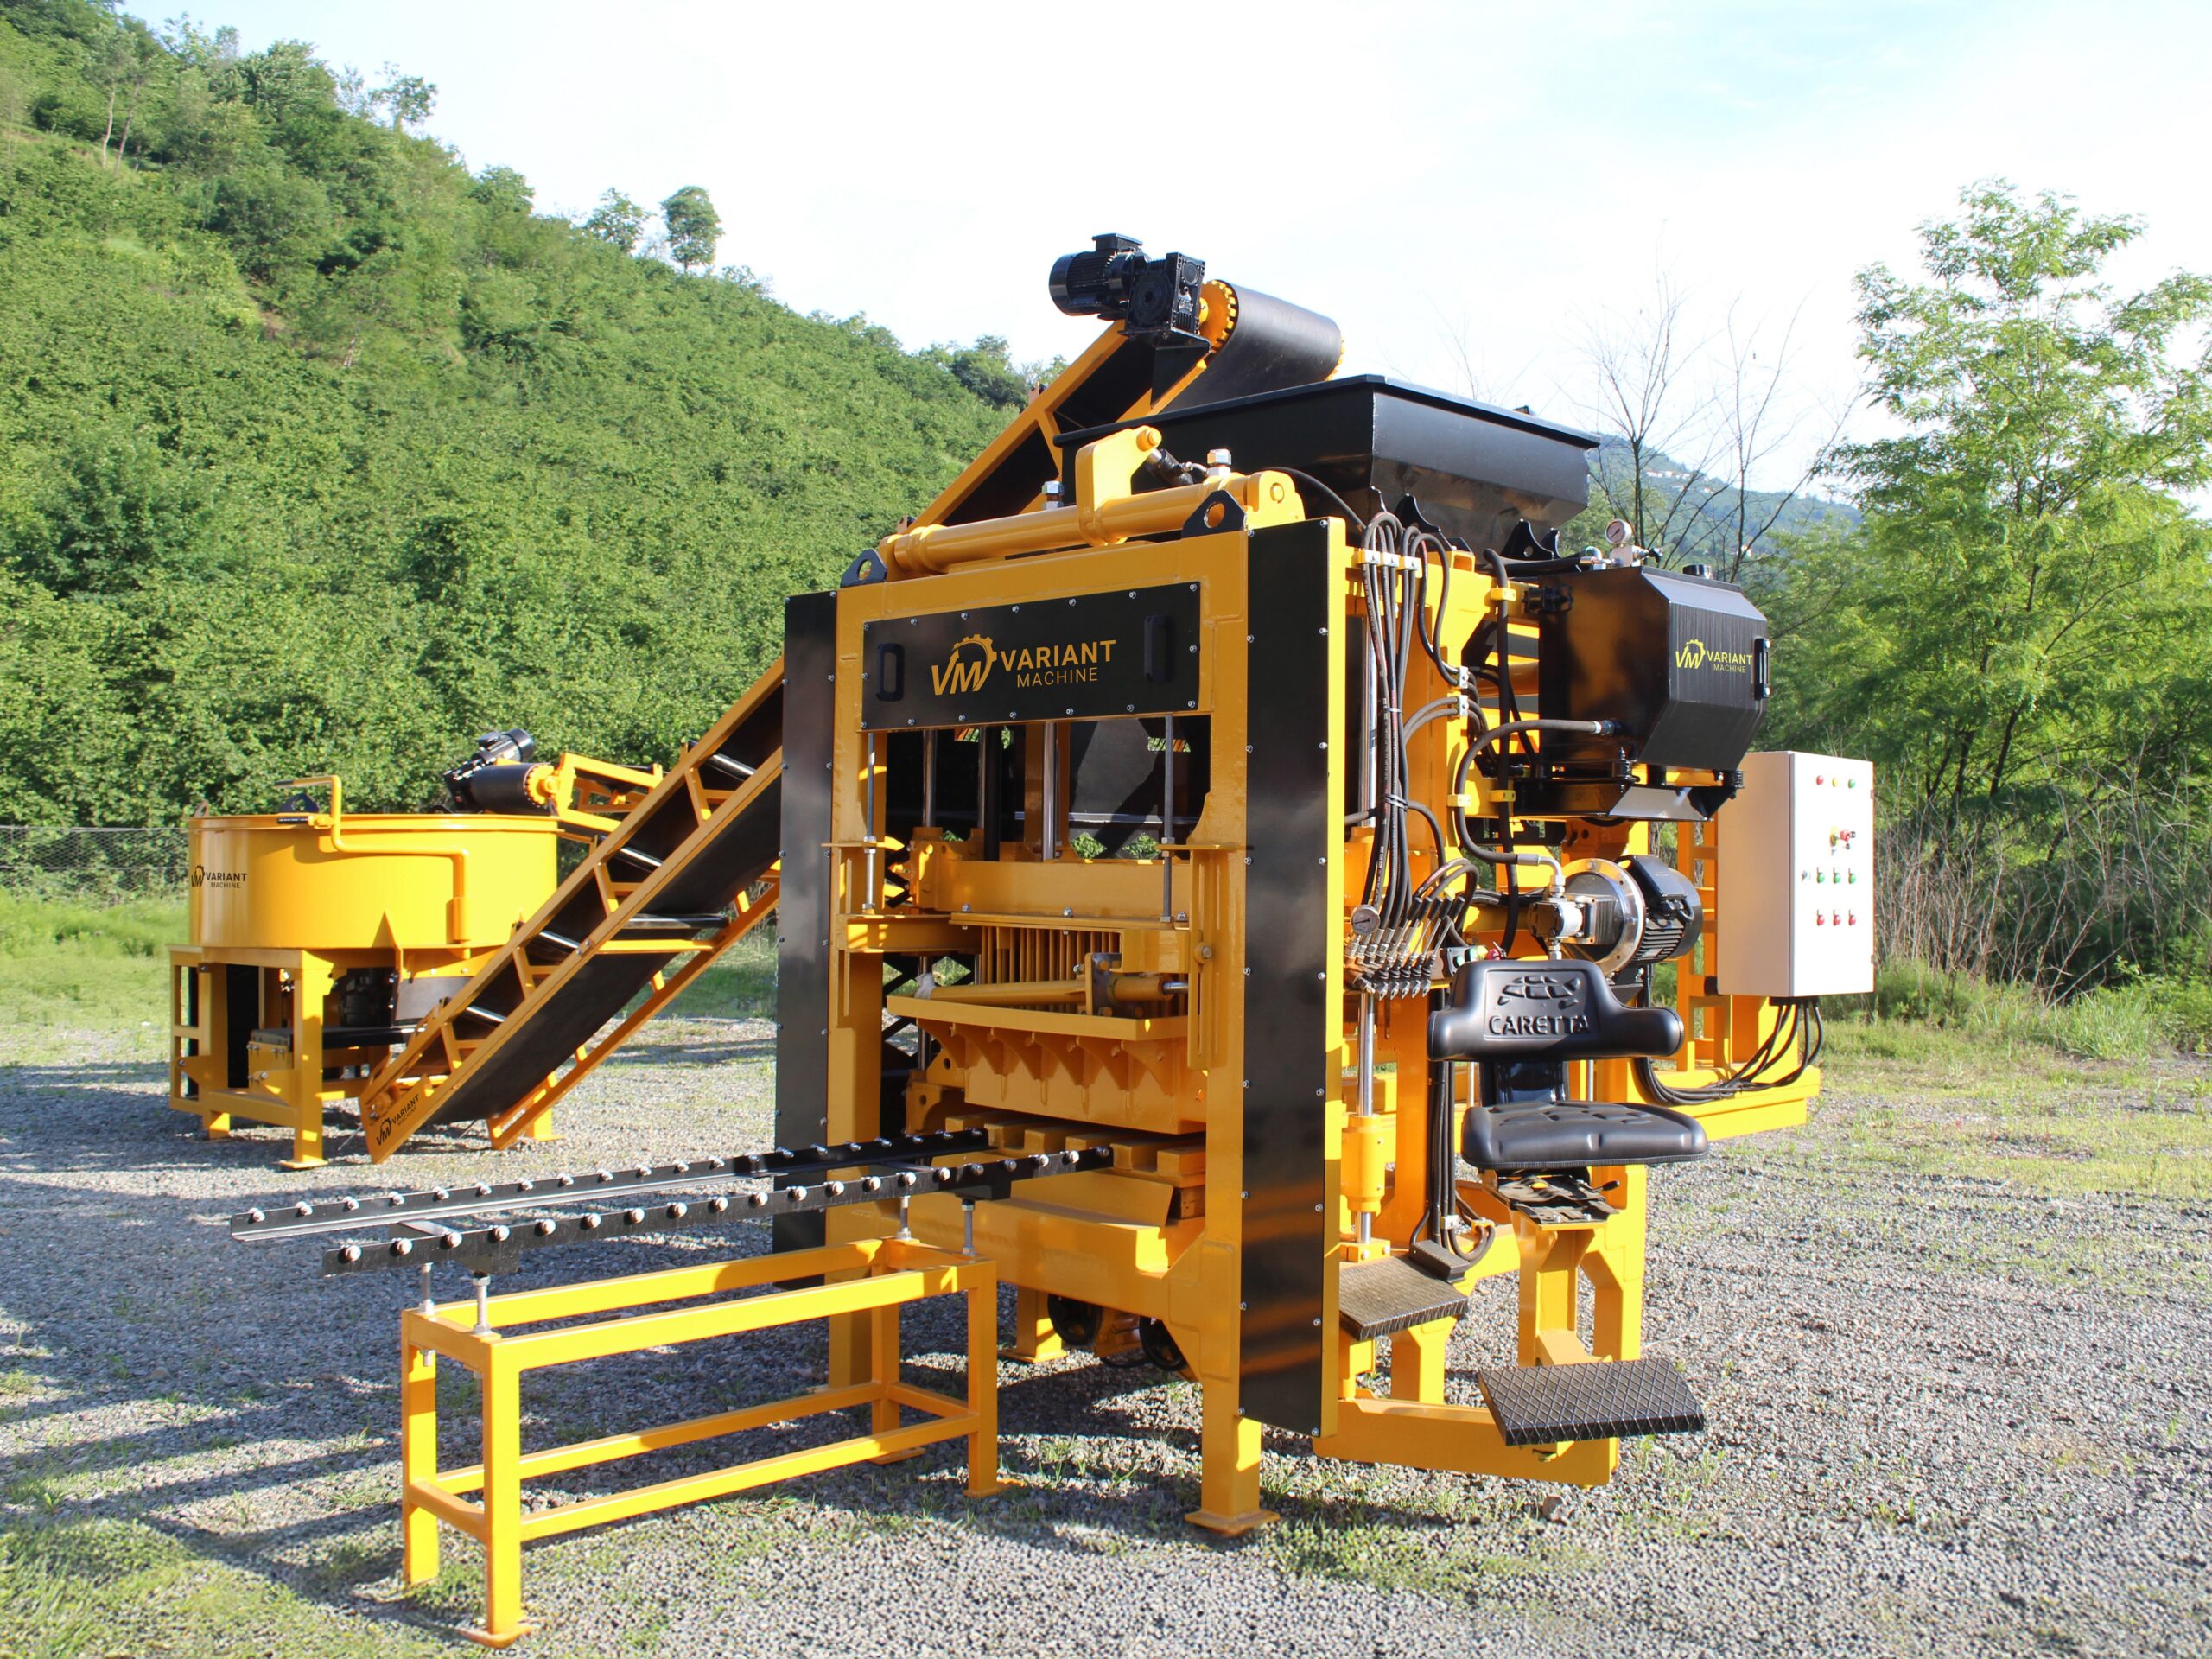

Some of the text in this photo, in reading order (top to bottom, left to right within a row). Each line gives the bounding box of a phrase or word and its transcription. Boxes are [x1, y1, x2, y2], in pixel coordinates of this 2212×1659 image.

[1000, 639, 1116, 671] VARIANT
[1707, 650, 1752, 665] VARIANT
[1016, 667, 1098, 688] MACHINE
[1713, 664, 1746, 674] MACHINE
[205, 872, 248, 882] VARIANT
[1489, 1015, 1589, 1036] CARETTA
[391, 1093, 419, 1124] VARIANT
